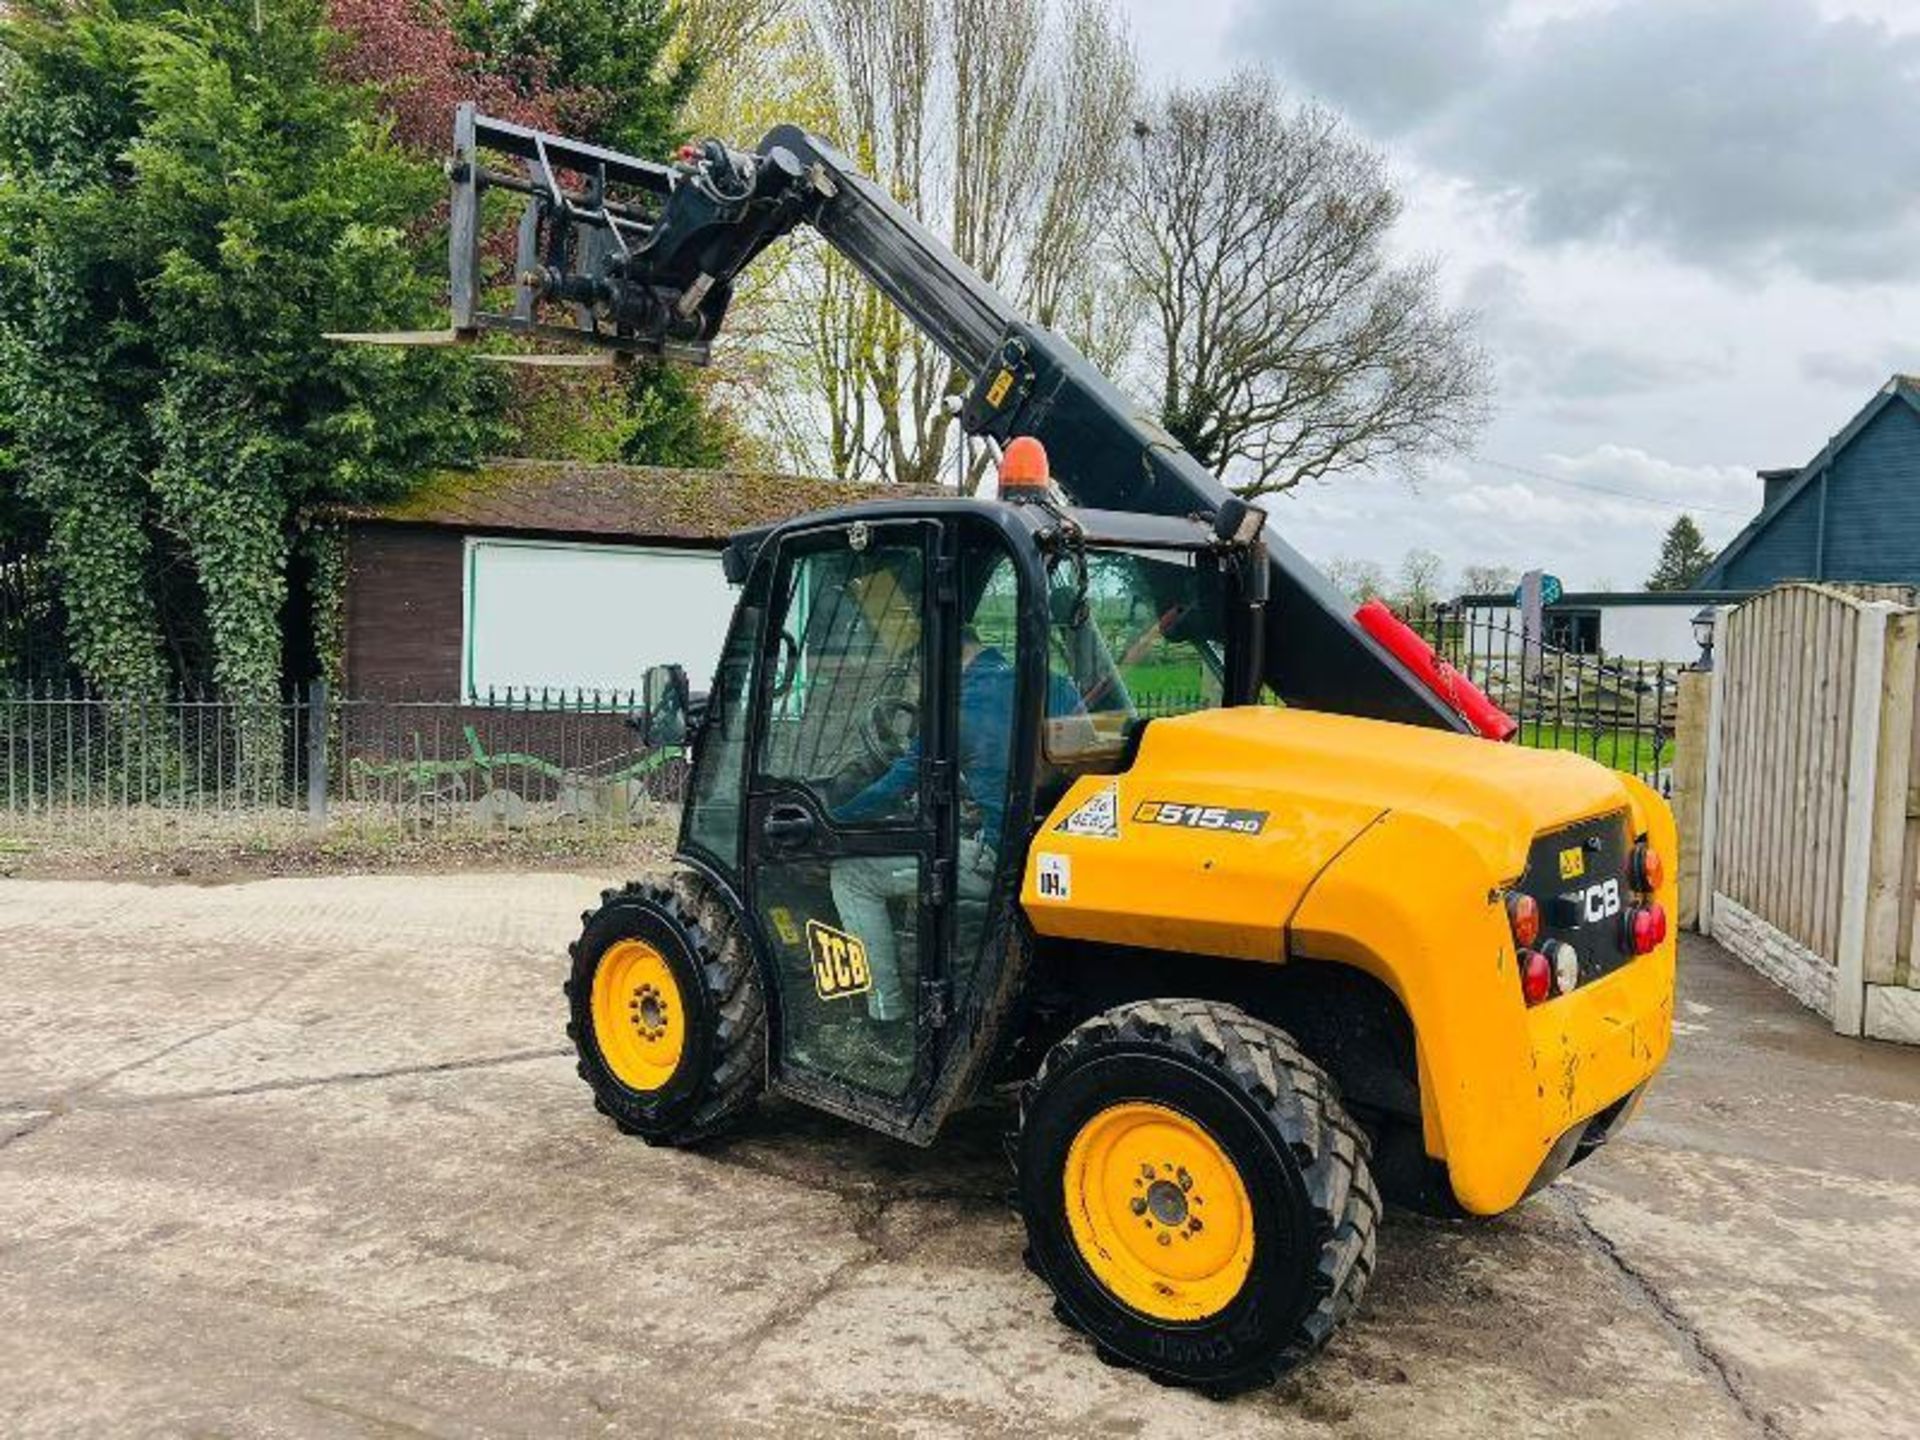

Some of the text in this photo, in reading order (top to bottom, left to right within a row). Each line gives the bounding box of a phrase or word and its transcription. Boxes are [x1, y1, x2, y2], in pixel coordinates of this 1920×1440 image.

[1156, 803, 1260, 832] 515-40
[1578, 877, 1621, 923] CB
[815, 929, 866, 992] JCB
